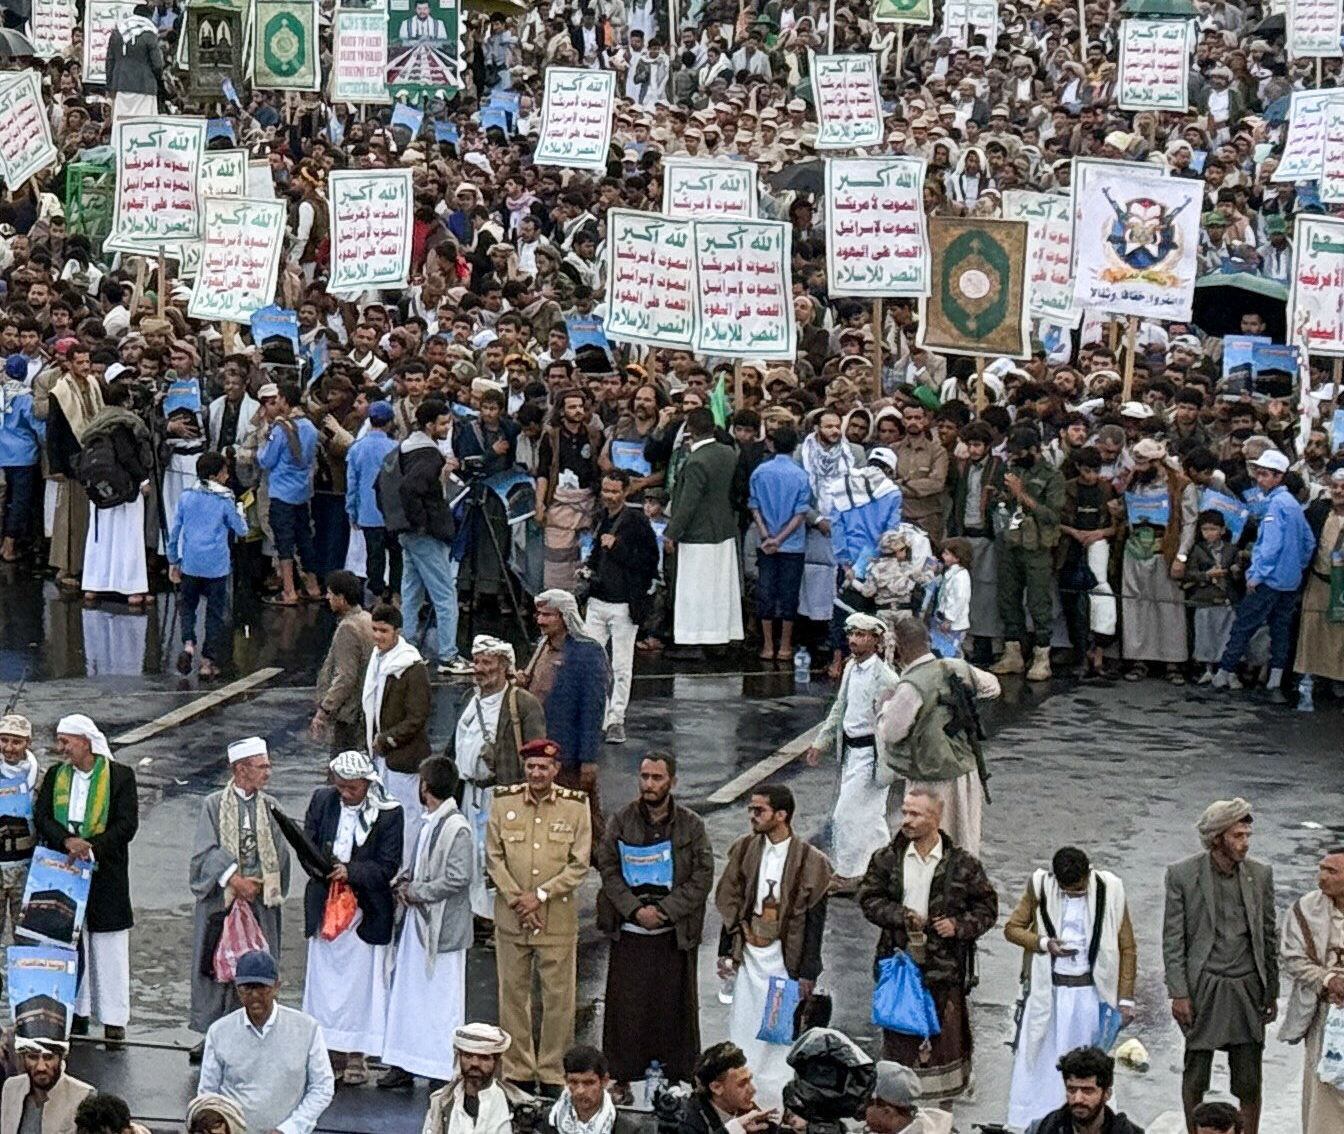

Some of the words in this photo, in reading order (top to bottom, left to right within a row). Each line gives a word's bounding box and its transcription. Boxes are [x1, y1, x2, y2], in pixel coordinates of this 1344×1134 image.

[168, 132, 196, 150] الله
[895, 169, 916, 187] الله
[378, 184, 403, 205] الله
[750, 230, 779, 251] الله
